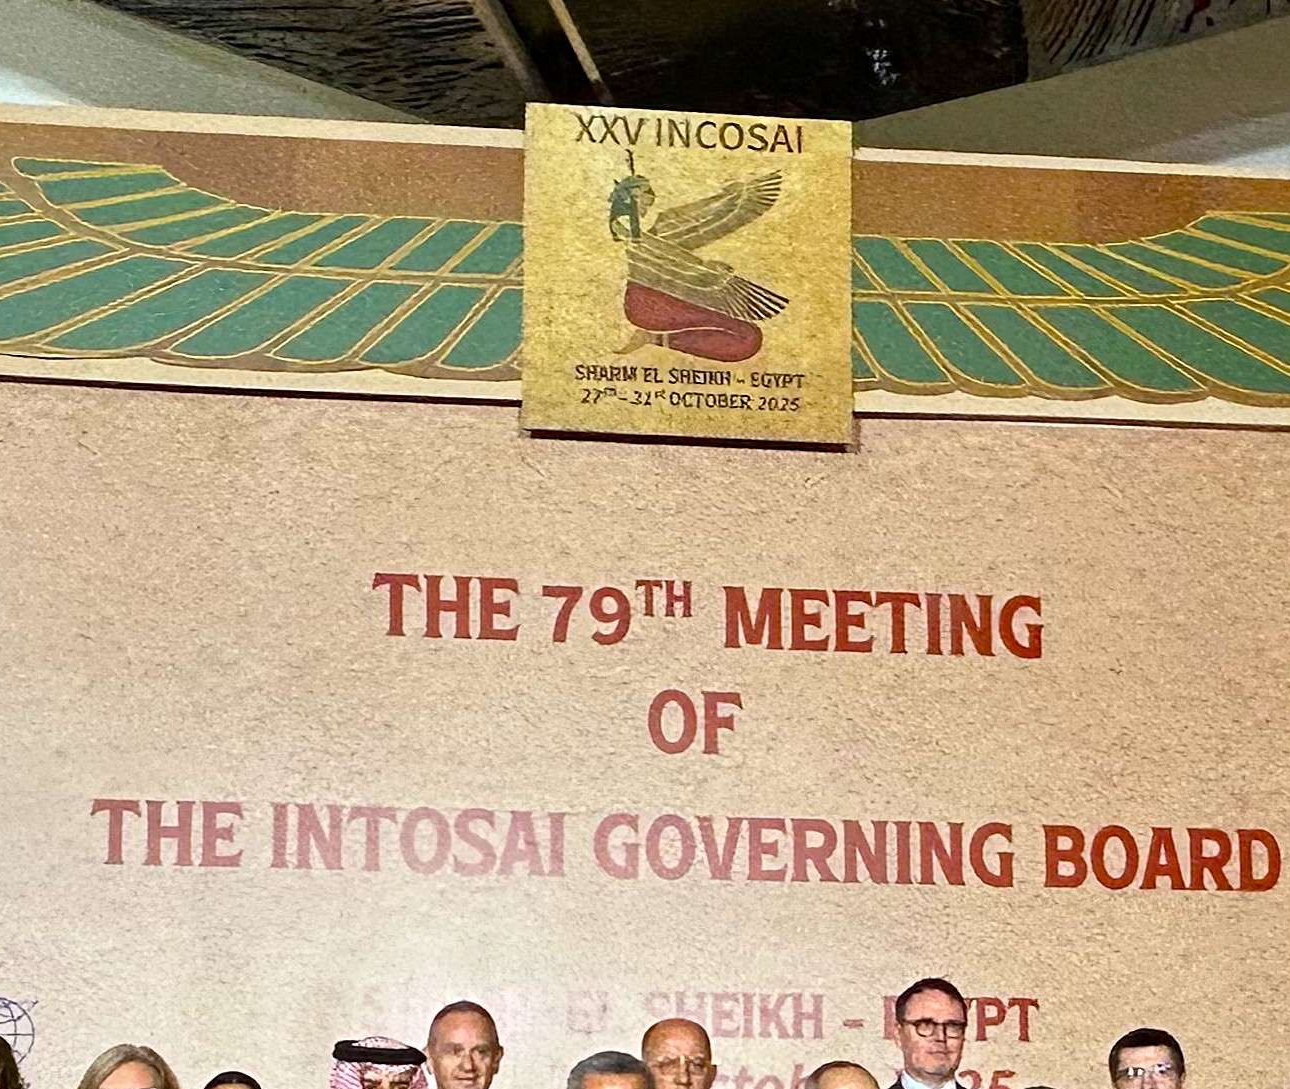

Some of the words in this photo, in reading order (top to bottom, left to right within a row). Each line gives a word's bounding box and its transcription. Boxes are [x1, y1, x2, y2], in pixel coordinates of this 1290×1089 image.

[572, 112, 647, 146] XXV
[655, 117, 803, 154] INCOSAI
[575, 364, 639, 383] SHARM
[642, 367, 664, 384] EL
[750, 371, 807, 389] EGYPT
[669, 391, 753, 411] OCTOBER
[757, 395, 801, 412] 2025
[372, 571, 523, 643] THE
[721, 584, 1045, 660] MEETING
[647, 687, 744, 756] OF
[90, 797, 244, 868] THE
[269, 802, 567, 878] INTOSAI
[592, 812, 1015, 890] GOVERNING
[1042, 823, 1283, 893] BOARD
[882, 994, 1041, 1043] EPT
